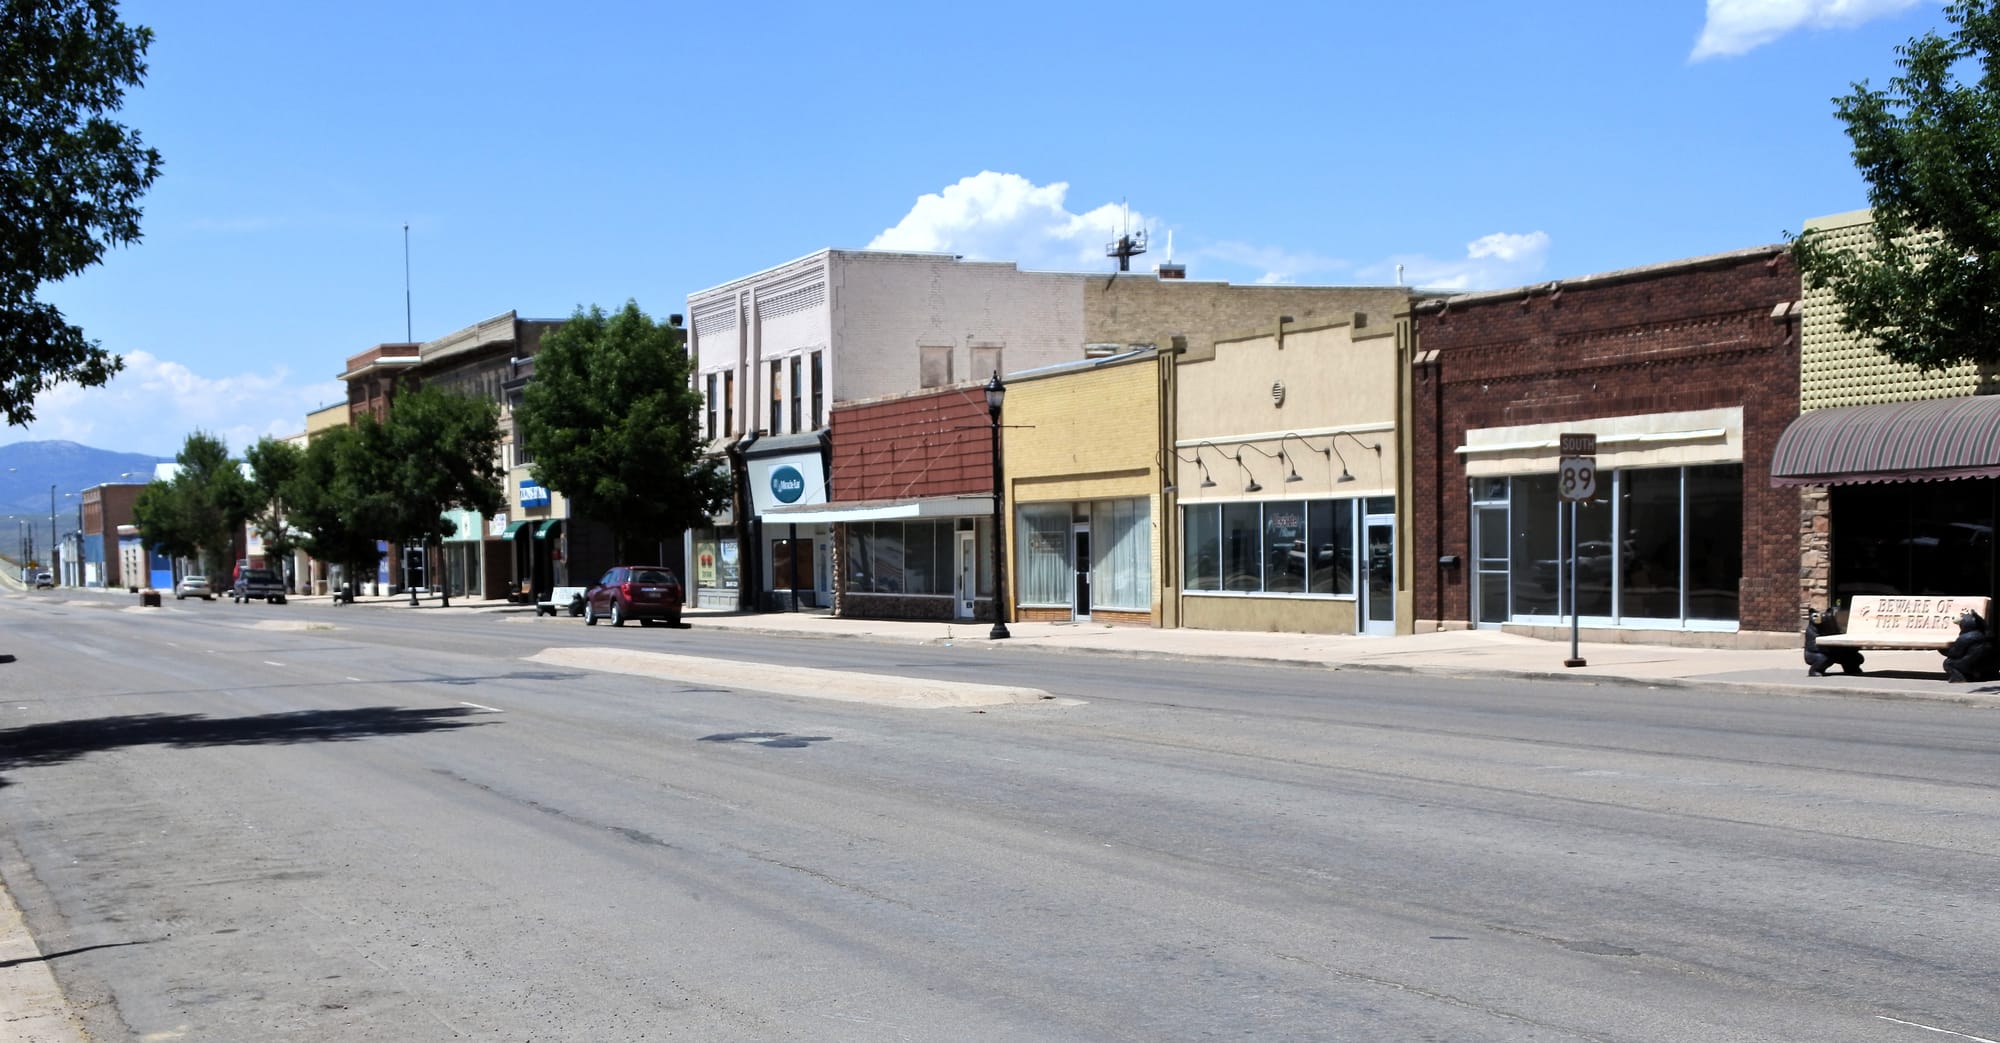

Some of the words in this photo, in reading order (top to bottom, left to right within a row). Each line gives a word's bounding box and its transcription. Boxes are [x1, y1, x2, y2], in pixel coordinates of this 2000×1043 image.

[1563, 438, 1594, 449] SOUTH
[1563, 467, 1591, 490] 89
[1877, 598, 1931, 613] BEWARE
[1936, 599, 1954, 613] OF
[1875, 614, 1902, 629] THE
[1906, 615, 1951, 629] BEARS
